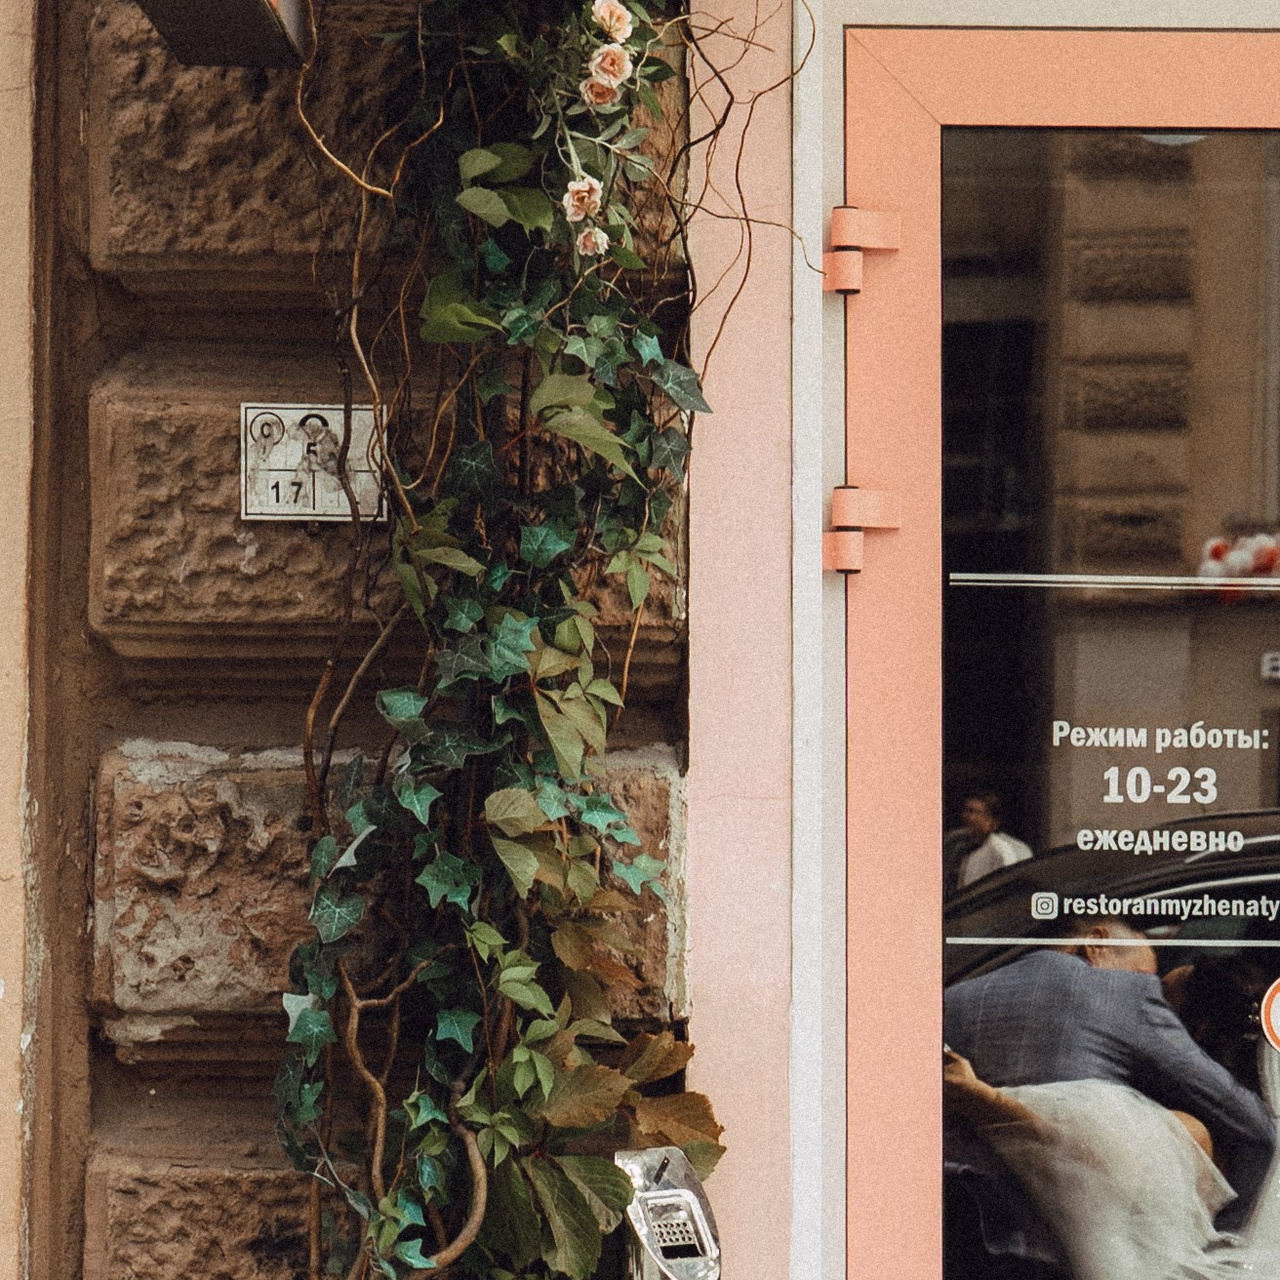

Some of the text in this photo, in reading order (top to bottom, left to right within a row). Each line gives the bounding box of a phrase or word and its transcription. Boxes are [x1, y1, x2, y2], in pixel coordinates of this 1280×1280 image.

[1053, 720, 1270, 754] Режим работы:
[1103, 766, 1218, 804] 10-23
[1076, 828, 1245, 856] ежедневно
[1063, 893, 1280, 921] restoranmyzhenaty
